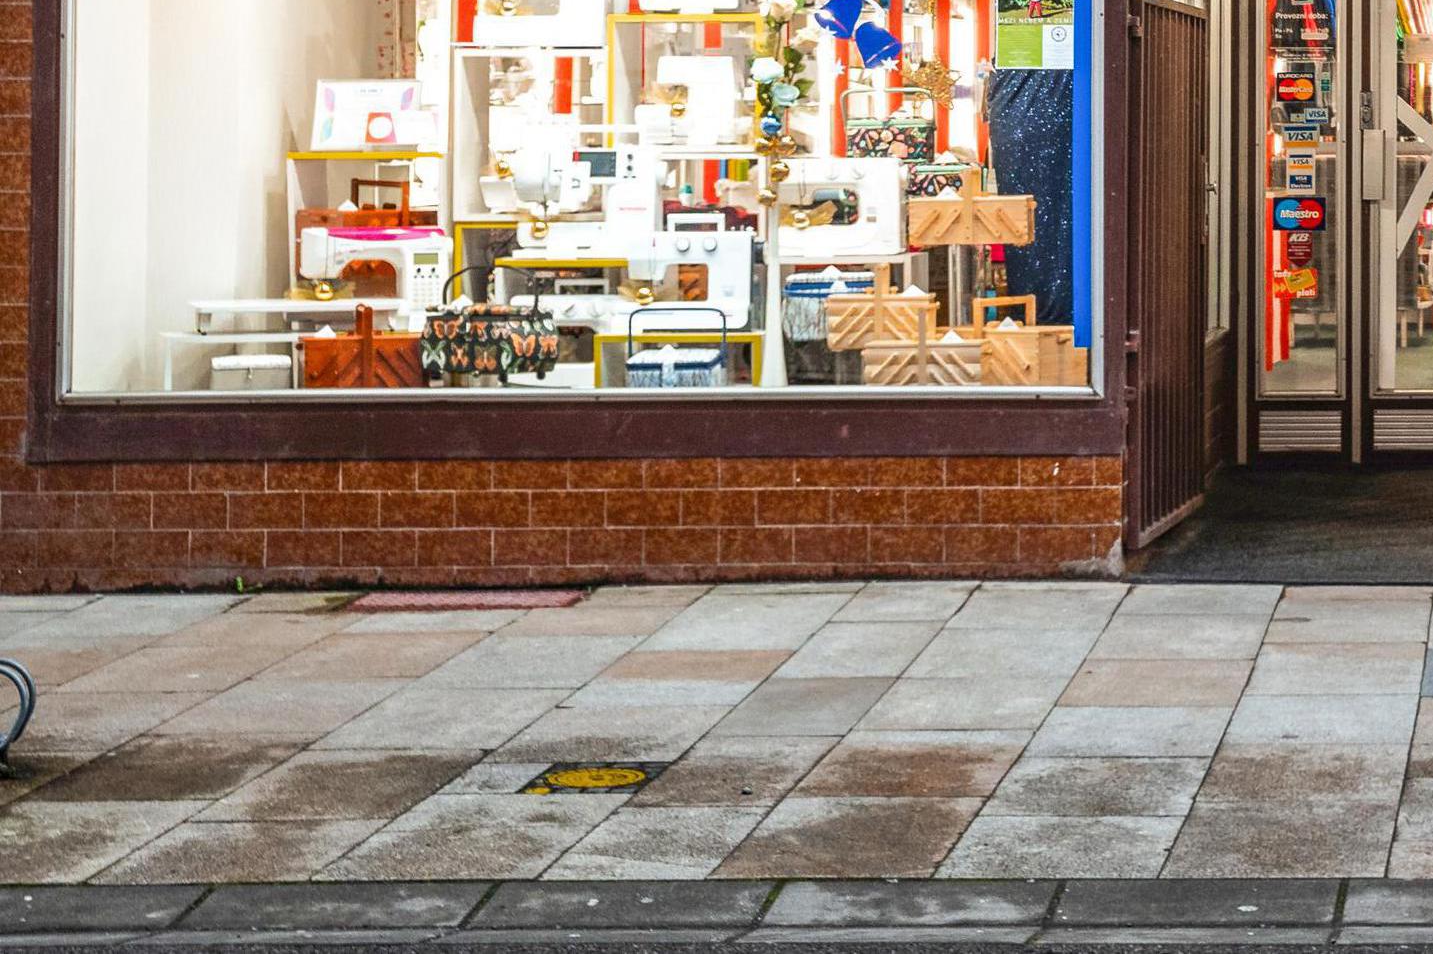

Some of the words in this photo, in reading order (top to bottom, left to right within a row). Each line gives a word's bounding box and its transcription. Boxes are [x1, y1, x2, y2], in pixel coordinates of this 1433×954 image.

[1308, 110, 1327, 118] VISA
[1287, 132, 1314, 141] VISA
[1280, 209, 1320, 219] Maestro
[1288, 233, 1310, 242] KB
